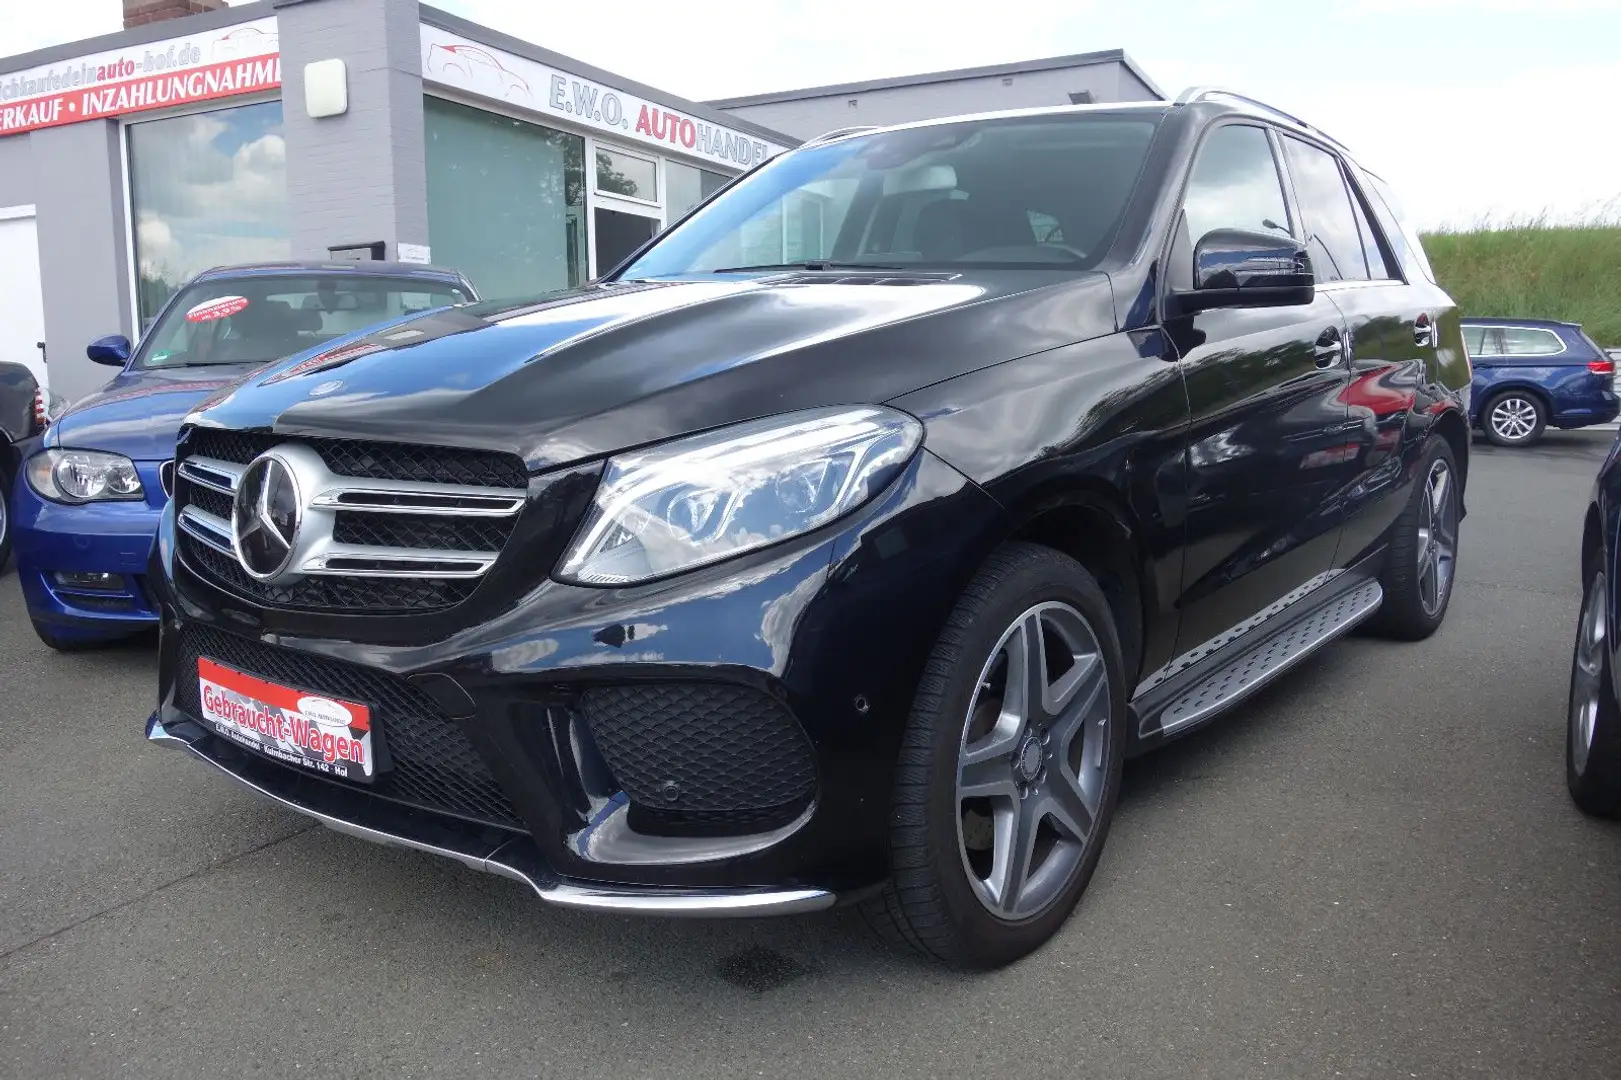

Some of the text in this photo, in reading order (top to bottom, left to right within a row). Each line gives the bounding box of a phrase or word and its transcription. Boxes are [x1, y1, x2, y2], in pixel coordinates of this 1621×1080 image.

[549, 73, 768, 168] E.W.O. AUTOHANDEL
[203, 684, 365, 764] Gebraucht-Wagen
[263, 744, 302, 765] Kulmbacher
[316, 761, 330, 774] 142
